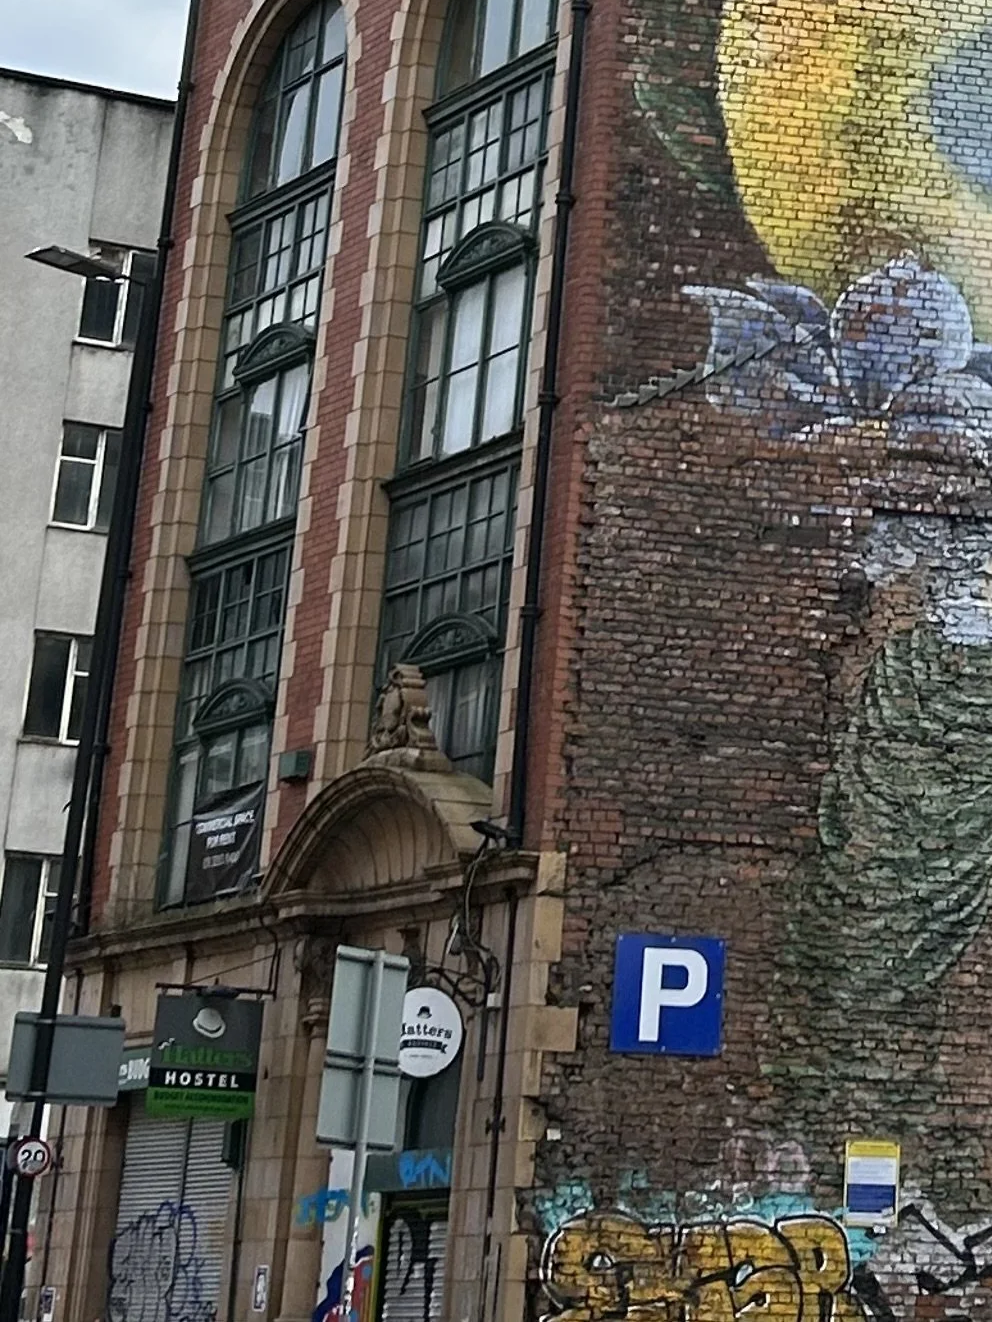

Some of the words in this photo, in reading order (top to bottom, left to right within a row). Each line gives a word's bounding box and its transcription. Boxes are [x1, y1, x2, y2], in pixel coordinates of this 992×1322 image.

[638, 947, 708, 1042] P
[164, 1071, 239, 1088] HOSTEL
[21, 1149, 46, 1169] 20
